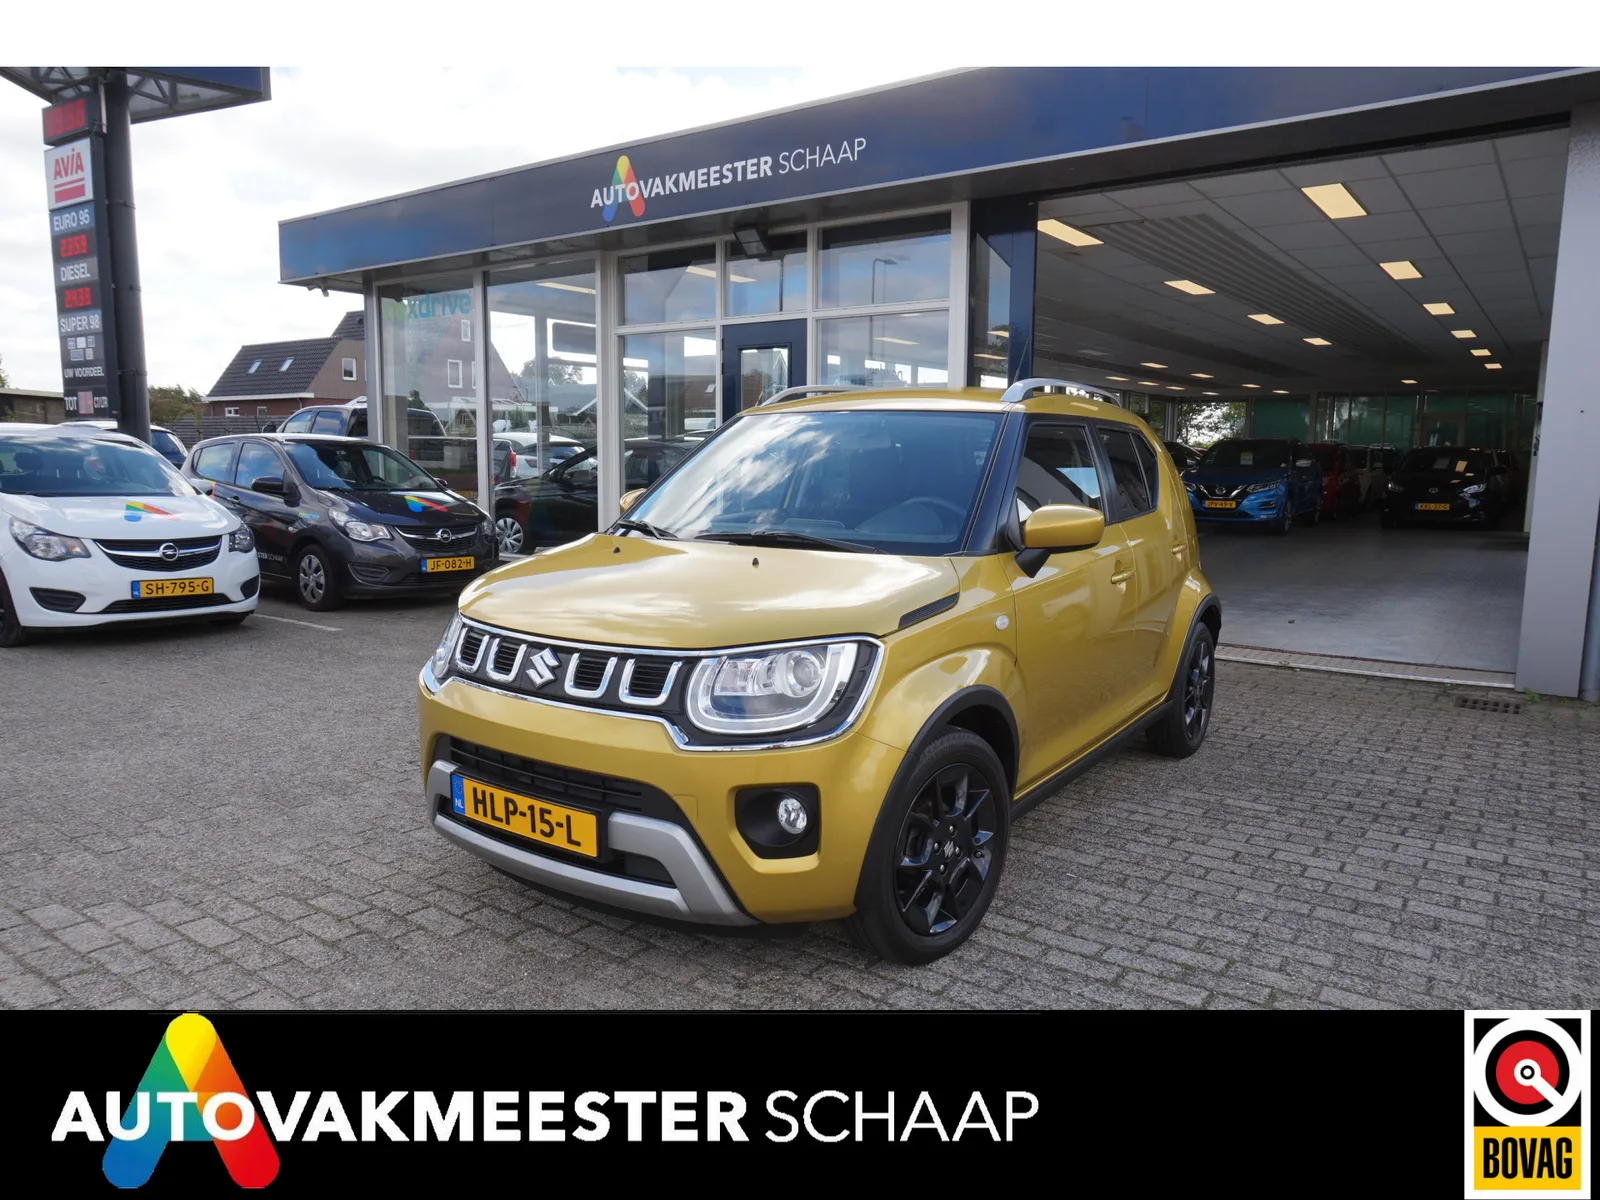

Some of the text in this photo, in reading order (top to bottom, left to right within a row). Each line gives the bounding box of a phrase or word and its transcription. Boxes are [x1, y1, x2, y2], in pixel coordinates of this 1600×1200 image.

[590, 137, 867, 208] AUTOVAKMEESTER SCHAAP
[53, 208, 91, 231] EURO 95
[60, 263, 90, 281] DIESEL
[60, 314, 100, 333] SUPER 98
[64, 366, 105, 378] UW VOORDEEL
[64, 396, 78, 411] TOT
[430, 558, 472, 571] JF-082-H
[145, 580, 209, 595] SH-795-G
[472, 786, 582, 848] HLP-15-L
